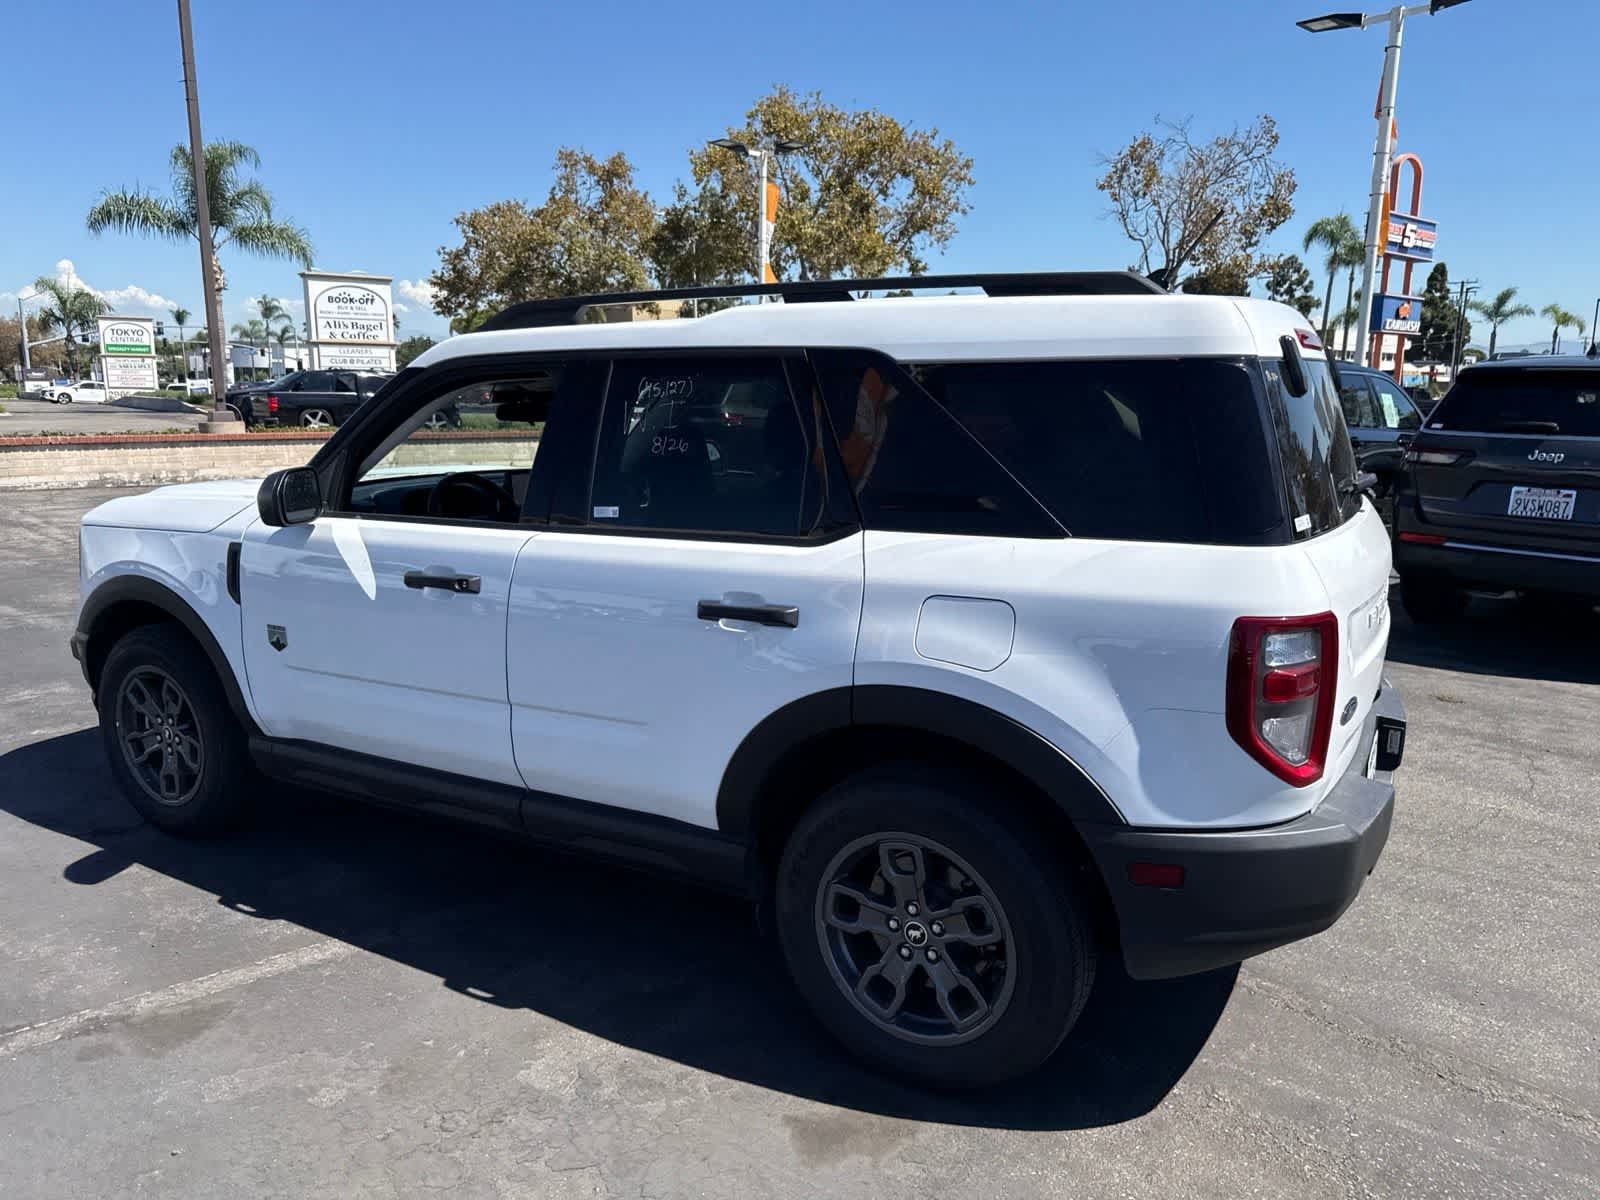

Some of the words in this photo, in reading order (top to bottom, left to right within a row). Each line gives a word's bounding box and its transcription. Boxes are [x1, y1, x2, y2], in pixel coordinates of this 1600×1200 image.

[1403, 222, 1417, 248] 5
[110, 328, 144, 336] TOKYO
[351, 321, 383, 332] Bagel
[341, 331, 379, 340] Coffee
[1527, 449, 1565, 464] Jeep
[1512, 497, 1570, 514] 9VSW087
